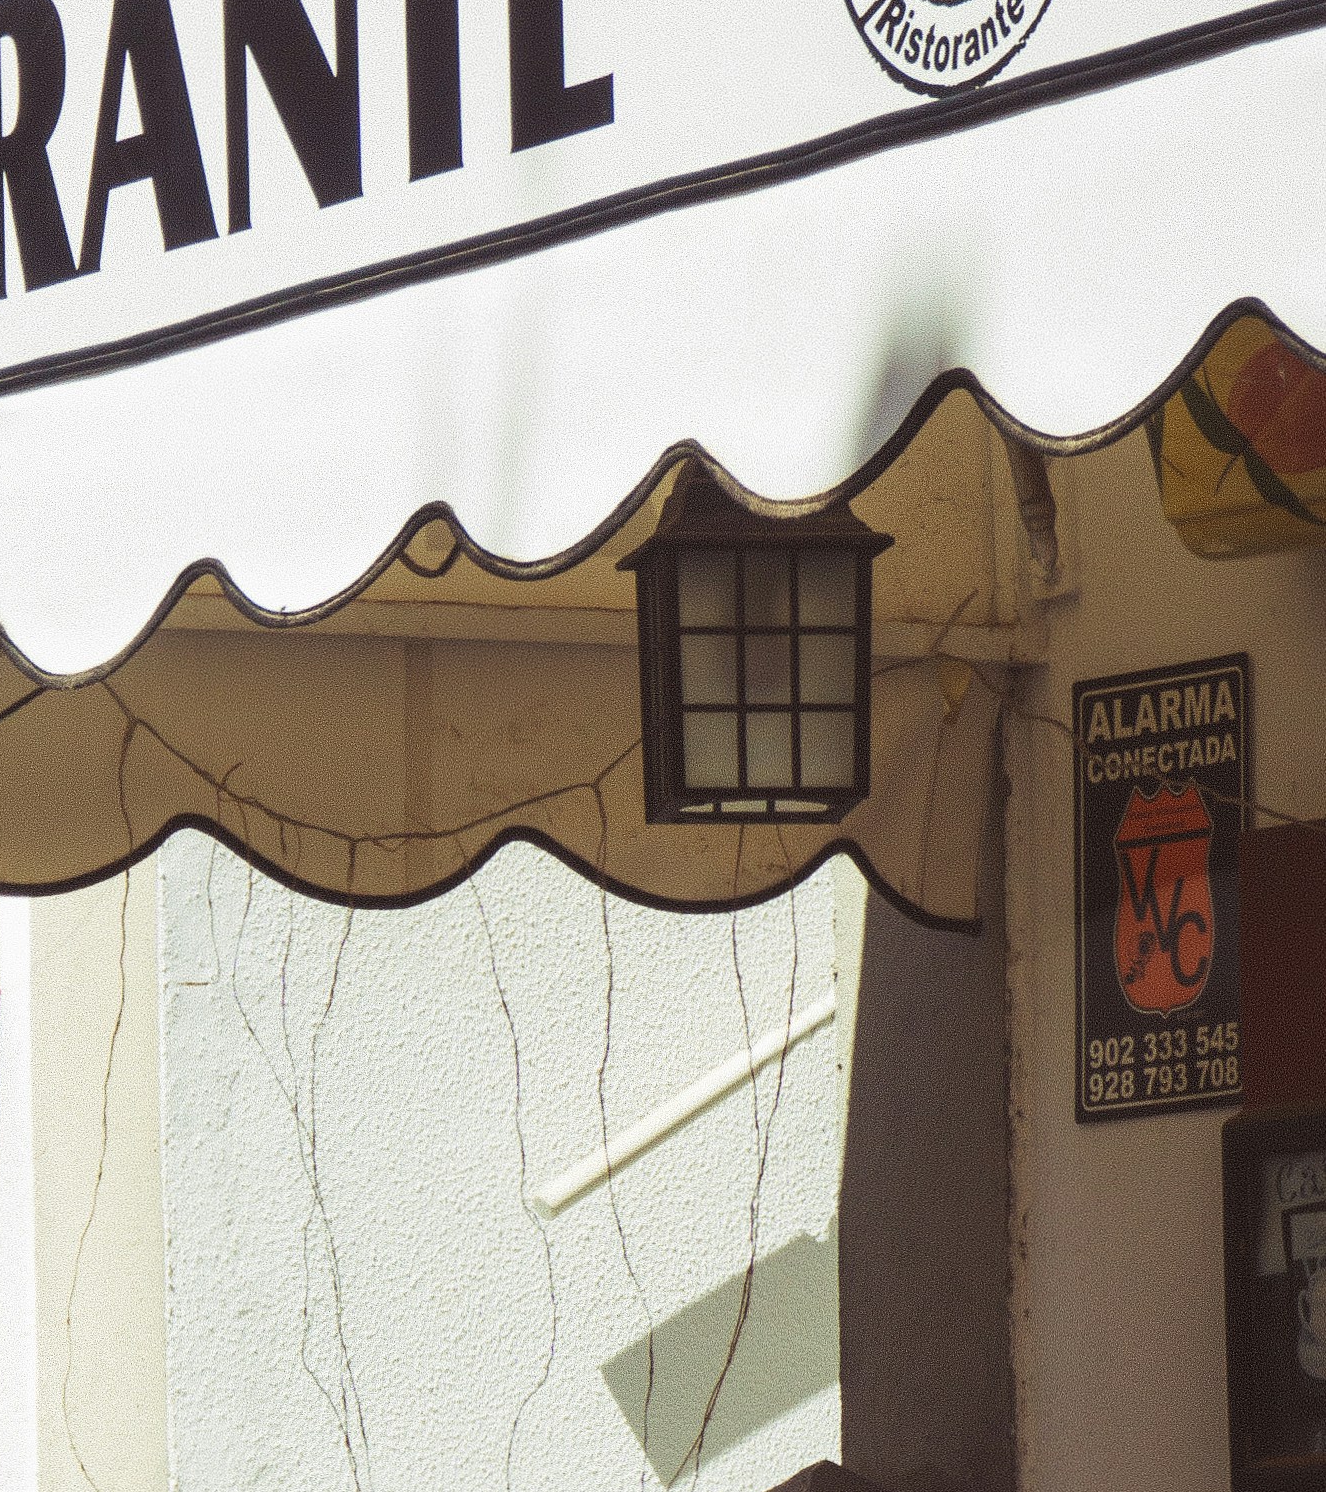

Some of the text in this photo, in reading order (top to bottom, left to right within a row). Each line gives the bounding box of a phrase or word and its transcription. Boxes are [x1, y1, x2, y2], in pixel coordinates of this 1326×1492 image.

[1087, 680, 1236, 745] ALARMA
[1087, 732, 1237, 784] CONECTADA
[1089, 1021, 1240, 1069] 902 333 545
[1089, 1056, 1239, 1102] 928 793 708
